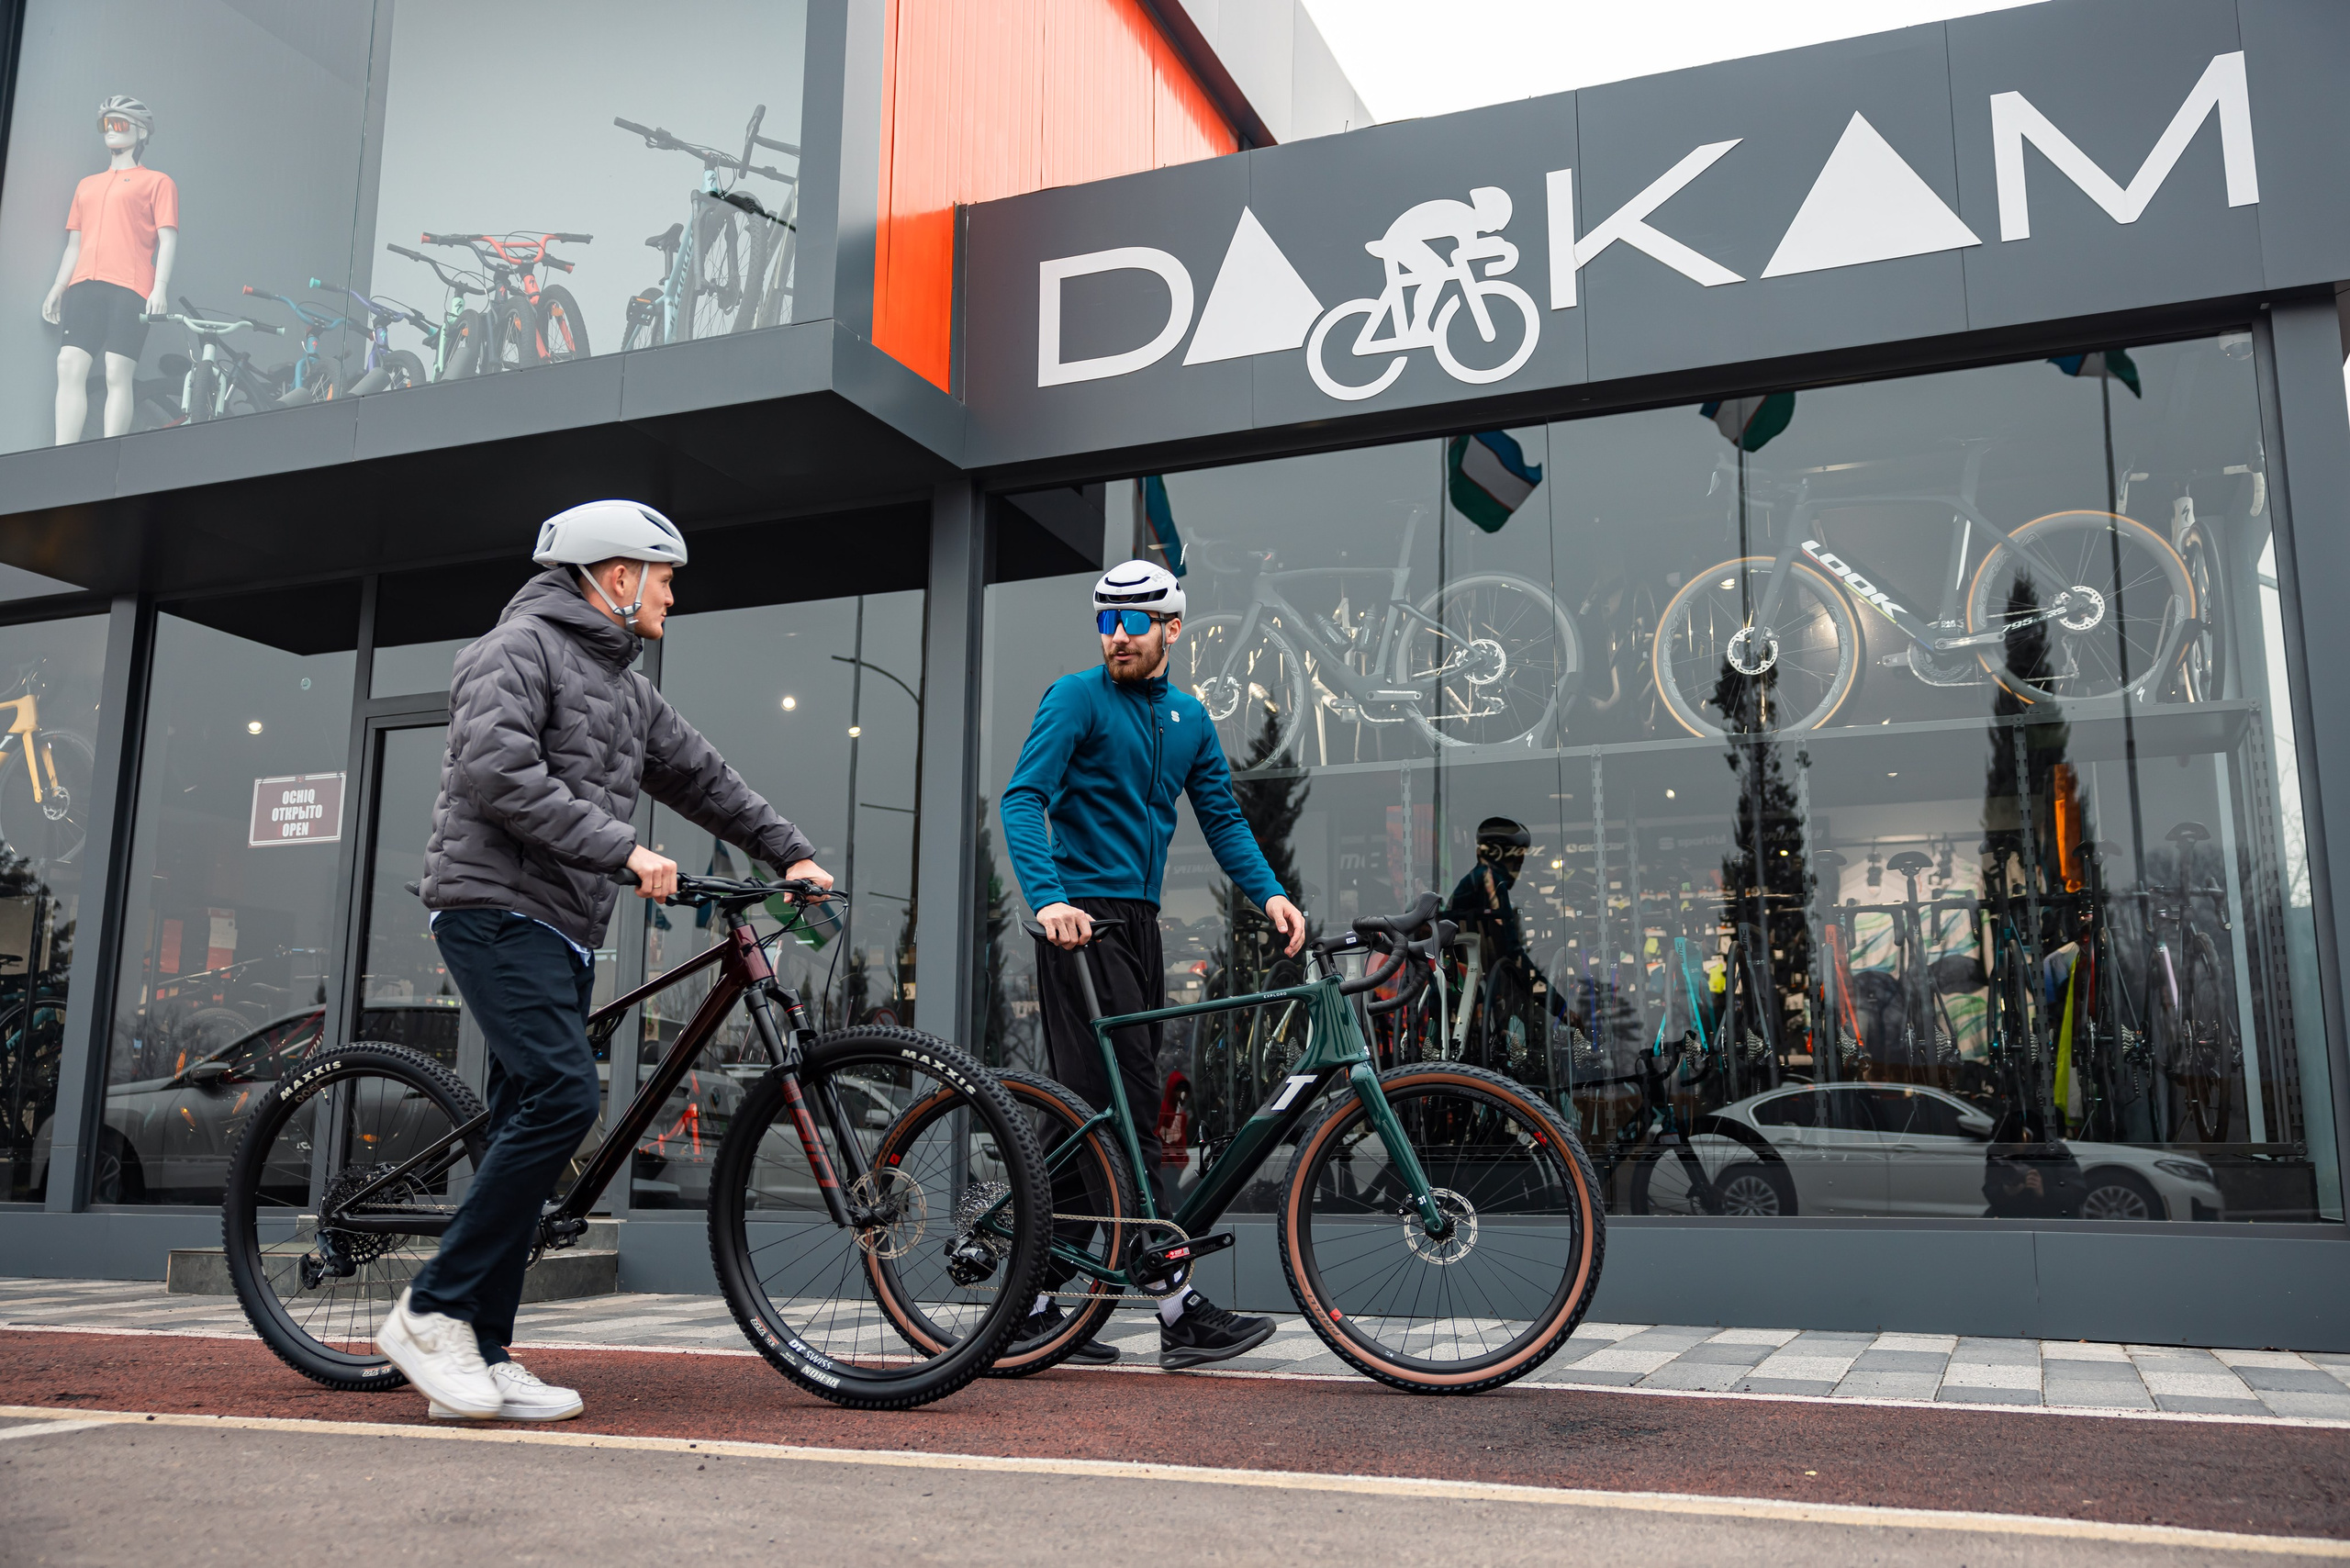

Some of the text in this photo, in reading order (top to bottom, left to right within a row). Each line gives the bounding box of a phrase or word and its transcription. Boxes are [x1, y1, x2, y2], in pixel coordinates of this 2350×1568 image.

[1801, 540, 1908, 619] LOOK
[2002, 617, 2033, 633] 795
[2045, 606, 2067, 619] RS
[1662, 600, 1702, 700] CORIMA
[1819, 604, 1849, 709] CORIMA
[271, 804, 323, 822] ОТКРЫТО
[282, 789, 316, 805] OCHIQ
[282, 822, 309, 837] OPEN
[279, 1060, 342, 1101] MAXXIS
[901, 1048, 977, 1095] MAXXIS
[1417, 1194, 1427, 1205] 3T
[1307, 1294, 1340, 1336] PIRELLI
[788, 1338, 807, 1352] DT
[803, 1350, 834, 1371] SWISS
